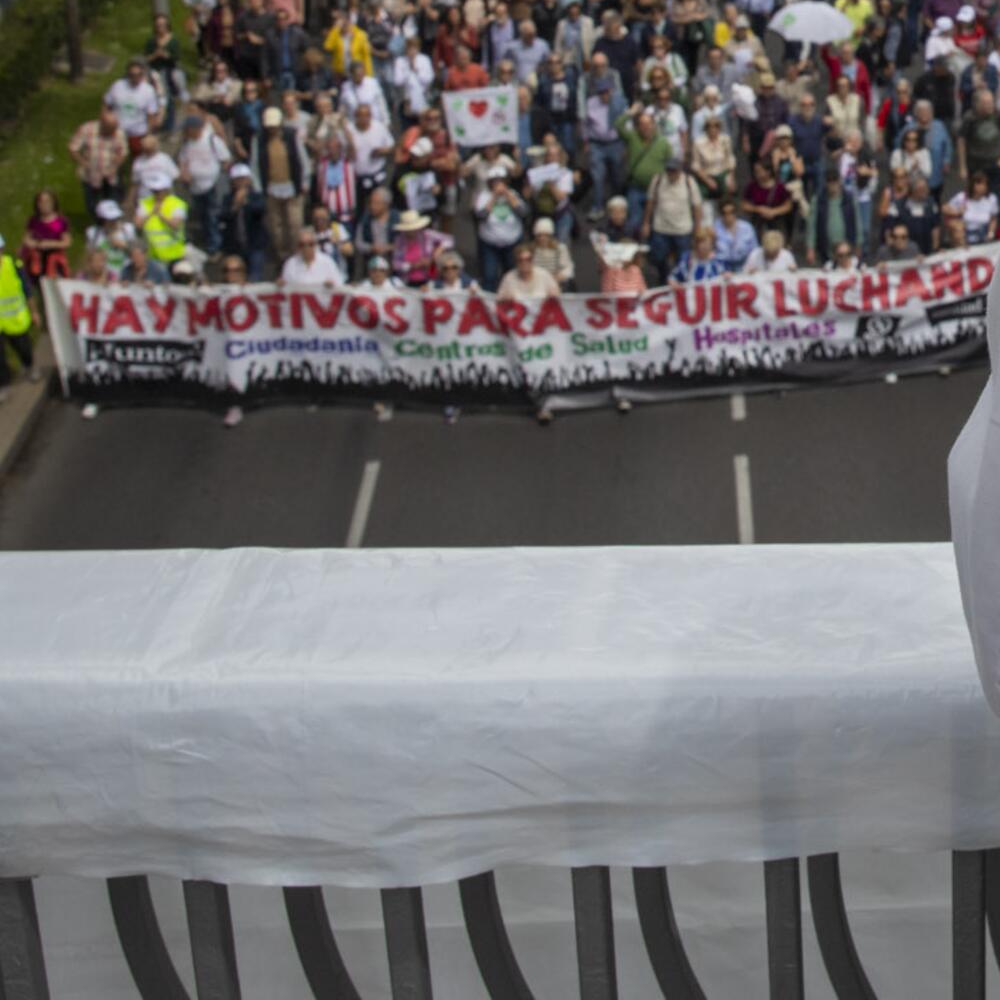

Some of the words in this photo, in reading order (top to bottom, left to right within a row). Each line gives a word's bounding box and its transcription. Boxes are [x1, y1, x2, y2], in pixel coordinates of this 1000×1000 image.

[69, 292, 176, 335] HAY
[185, 293, 410, 336] MOTIVOS
[421, 294, 573, 337] PARA
[585, 282, 761, 330] SEGUIR
[772, 258, 995, 317] LUCHAND
[394, 340, 506, 360] Centros
[519, 344, 553, 362] de
[571, 333, 648, 356] Salud
[694, 320, 837, 350] Hospitales
